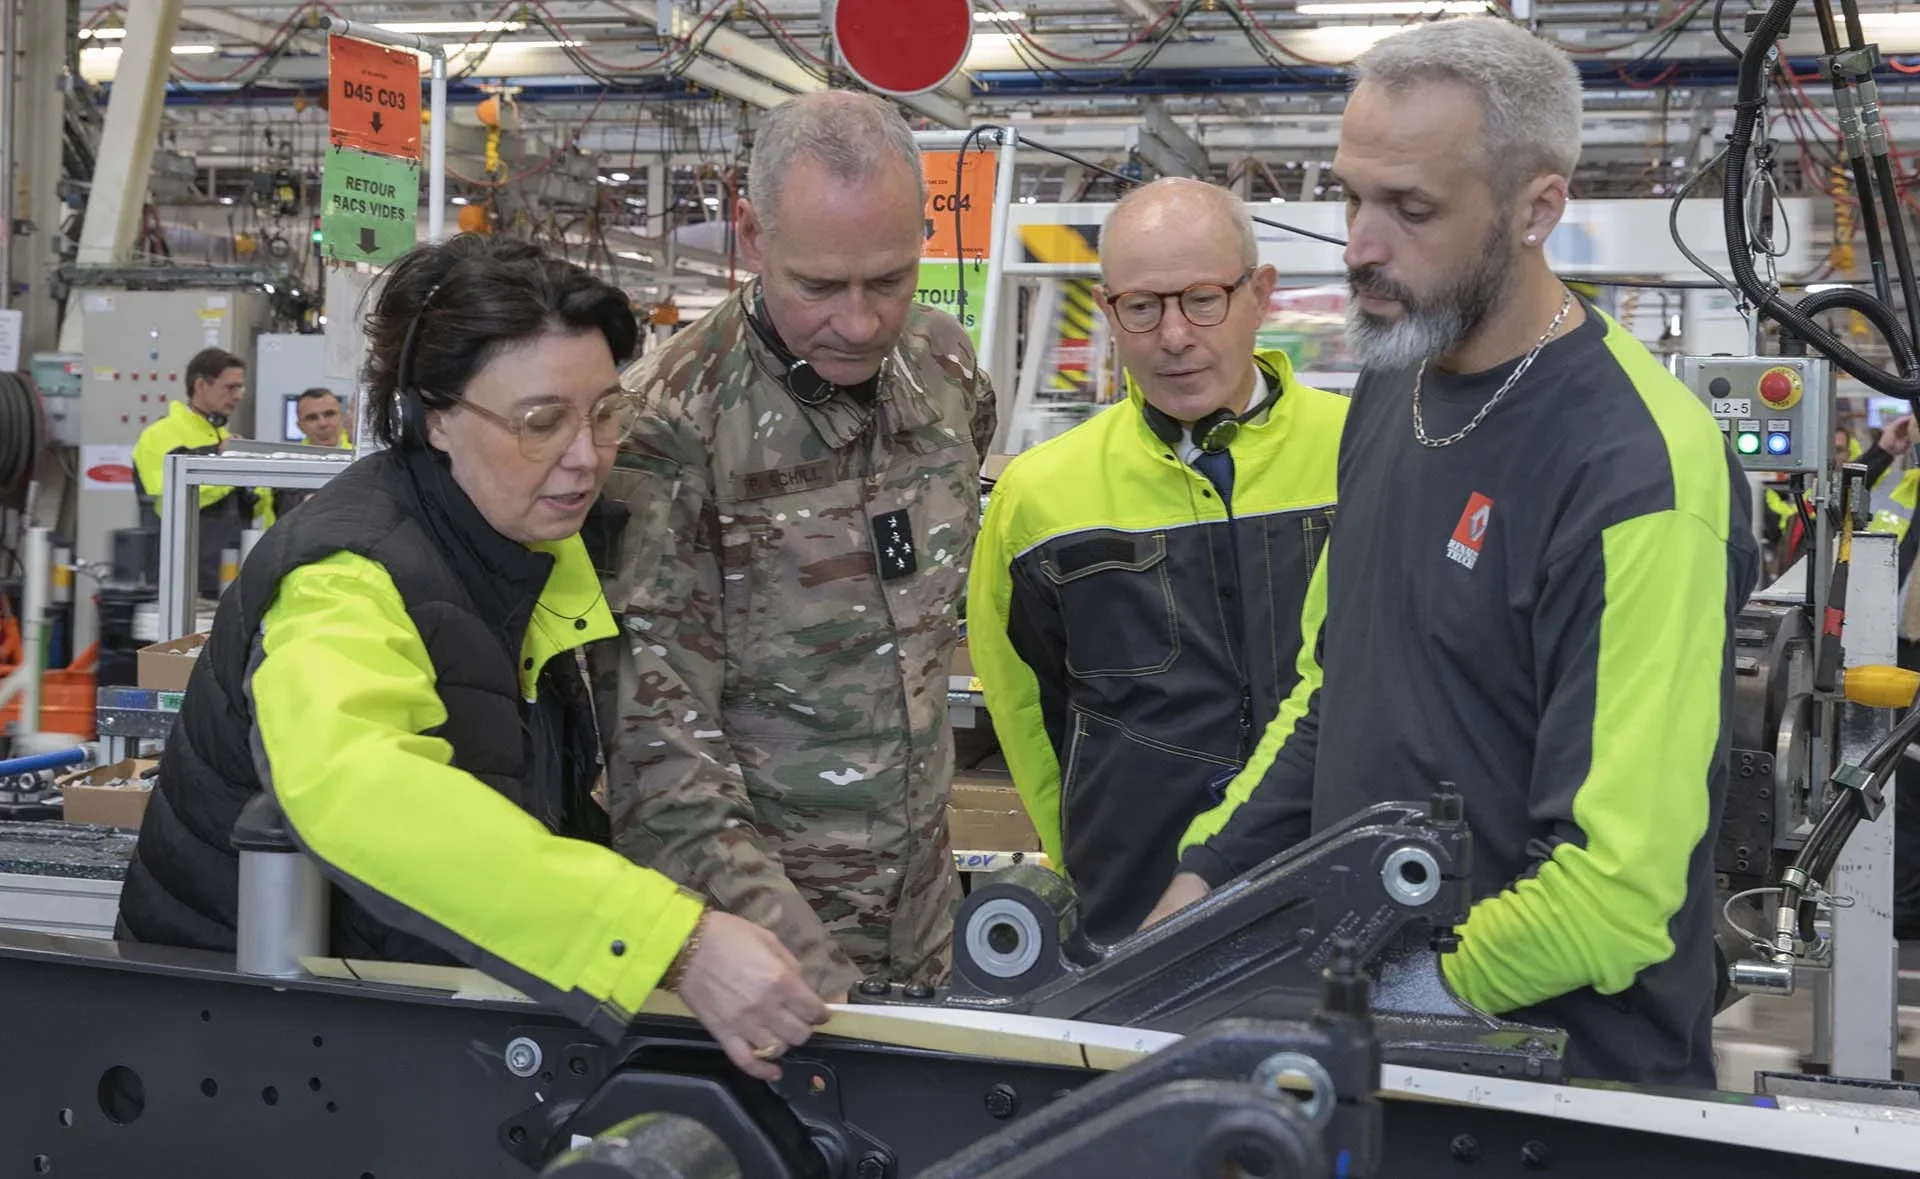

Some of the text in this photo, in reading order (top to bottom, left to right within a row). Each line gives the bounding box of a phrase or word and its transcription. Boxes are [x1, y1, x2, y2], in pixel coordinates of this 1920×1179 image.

[344, 81, 406, 110] D45 C03
[345, 175, 396, 199] RETOUR
[333, 194, 405, 222] BACS VIDES
[932, 194, 971, 212] C04
[912, 288, 969, 306] TOUR
